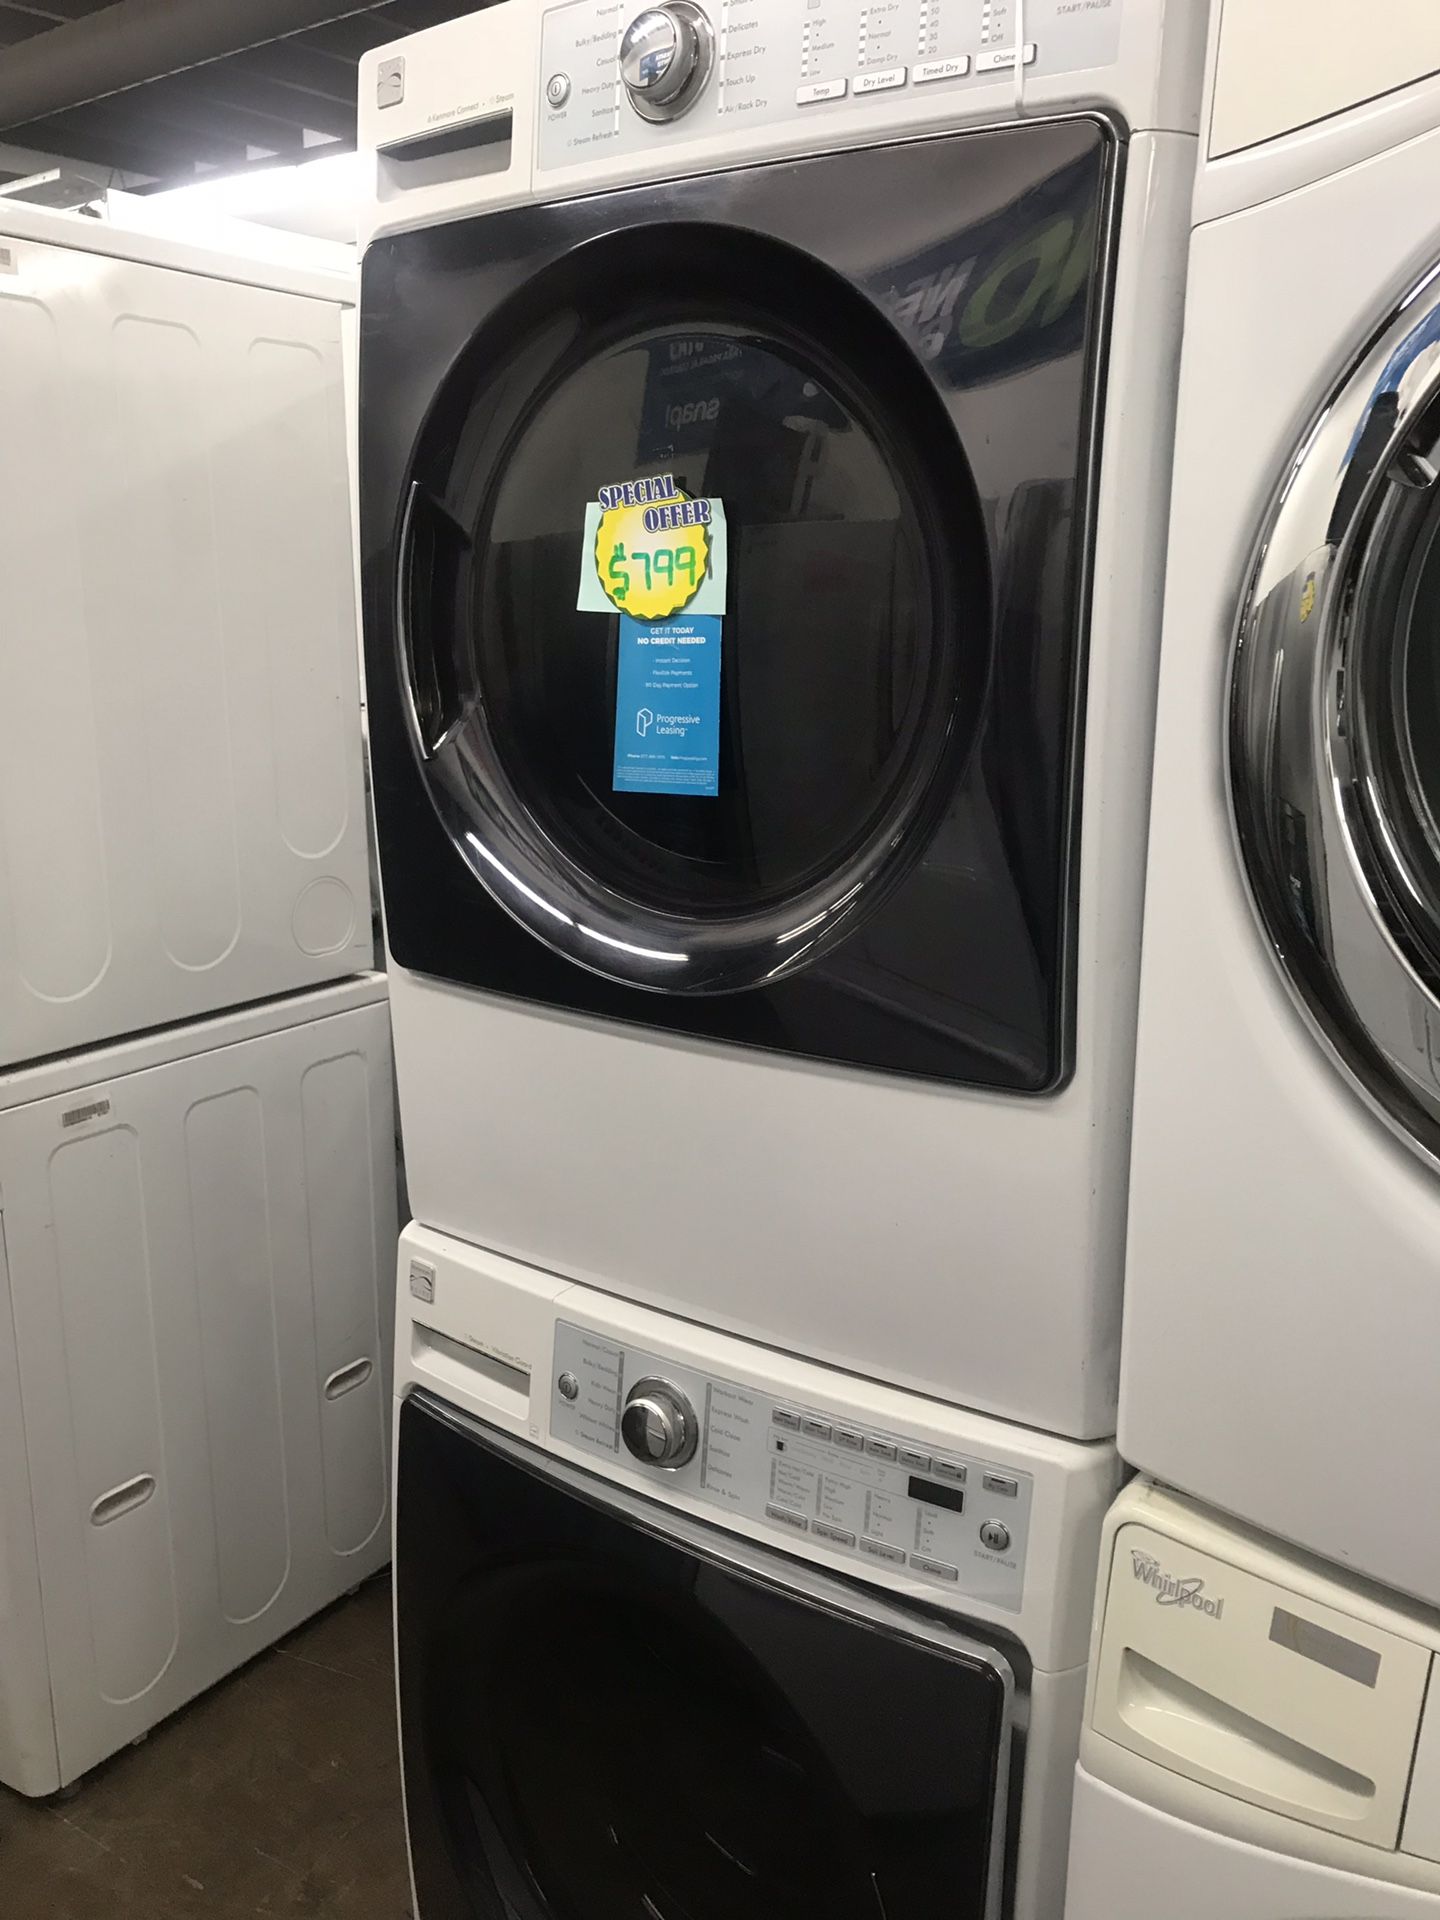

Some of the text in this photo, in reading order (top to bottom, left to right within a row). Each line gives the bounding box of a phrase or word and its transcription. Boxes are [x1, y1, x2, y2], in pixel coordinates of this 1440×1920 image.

[887, 3, 900, 12] Dry
[930, 6, 940, 15] 50
[728, 21, 759, 33] Delicates
[929, 19, 939, 28] 40
[929, 32, 938, 41] 30
[991, 33, 1004, 42] Off
[727, 46, 766, 60] Express Dry
[928, 45, 938, 54] 20
[886, 53, 898, 62] Dry
[993, 54, 1016, 63] Chime
[922, 63, 959, 76] Timed Dry
[725, 74, 756, 87] Touch Up
[863, 74, 896, 88] Dry Level
[601, 81, 615, 91] Duty
[813, 87, 830, 97] Temp
[755, 98, 768, 108] Dry
[599, 475, 677, 510] SPECIAL
[644, 500, 710, 532] OFFER
[608, 543, 696, 600] $799
[650, 627, 663, 635] GET
[672, 626, 695, 634] TODAY
[637, 636, 706, 645] NO CREDIT NEEDED
[656, 713, 701, 726] Progressive
[1131, 1556, 1224, 1621] Whirlpool
